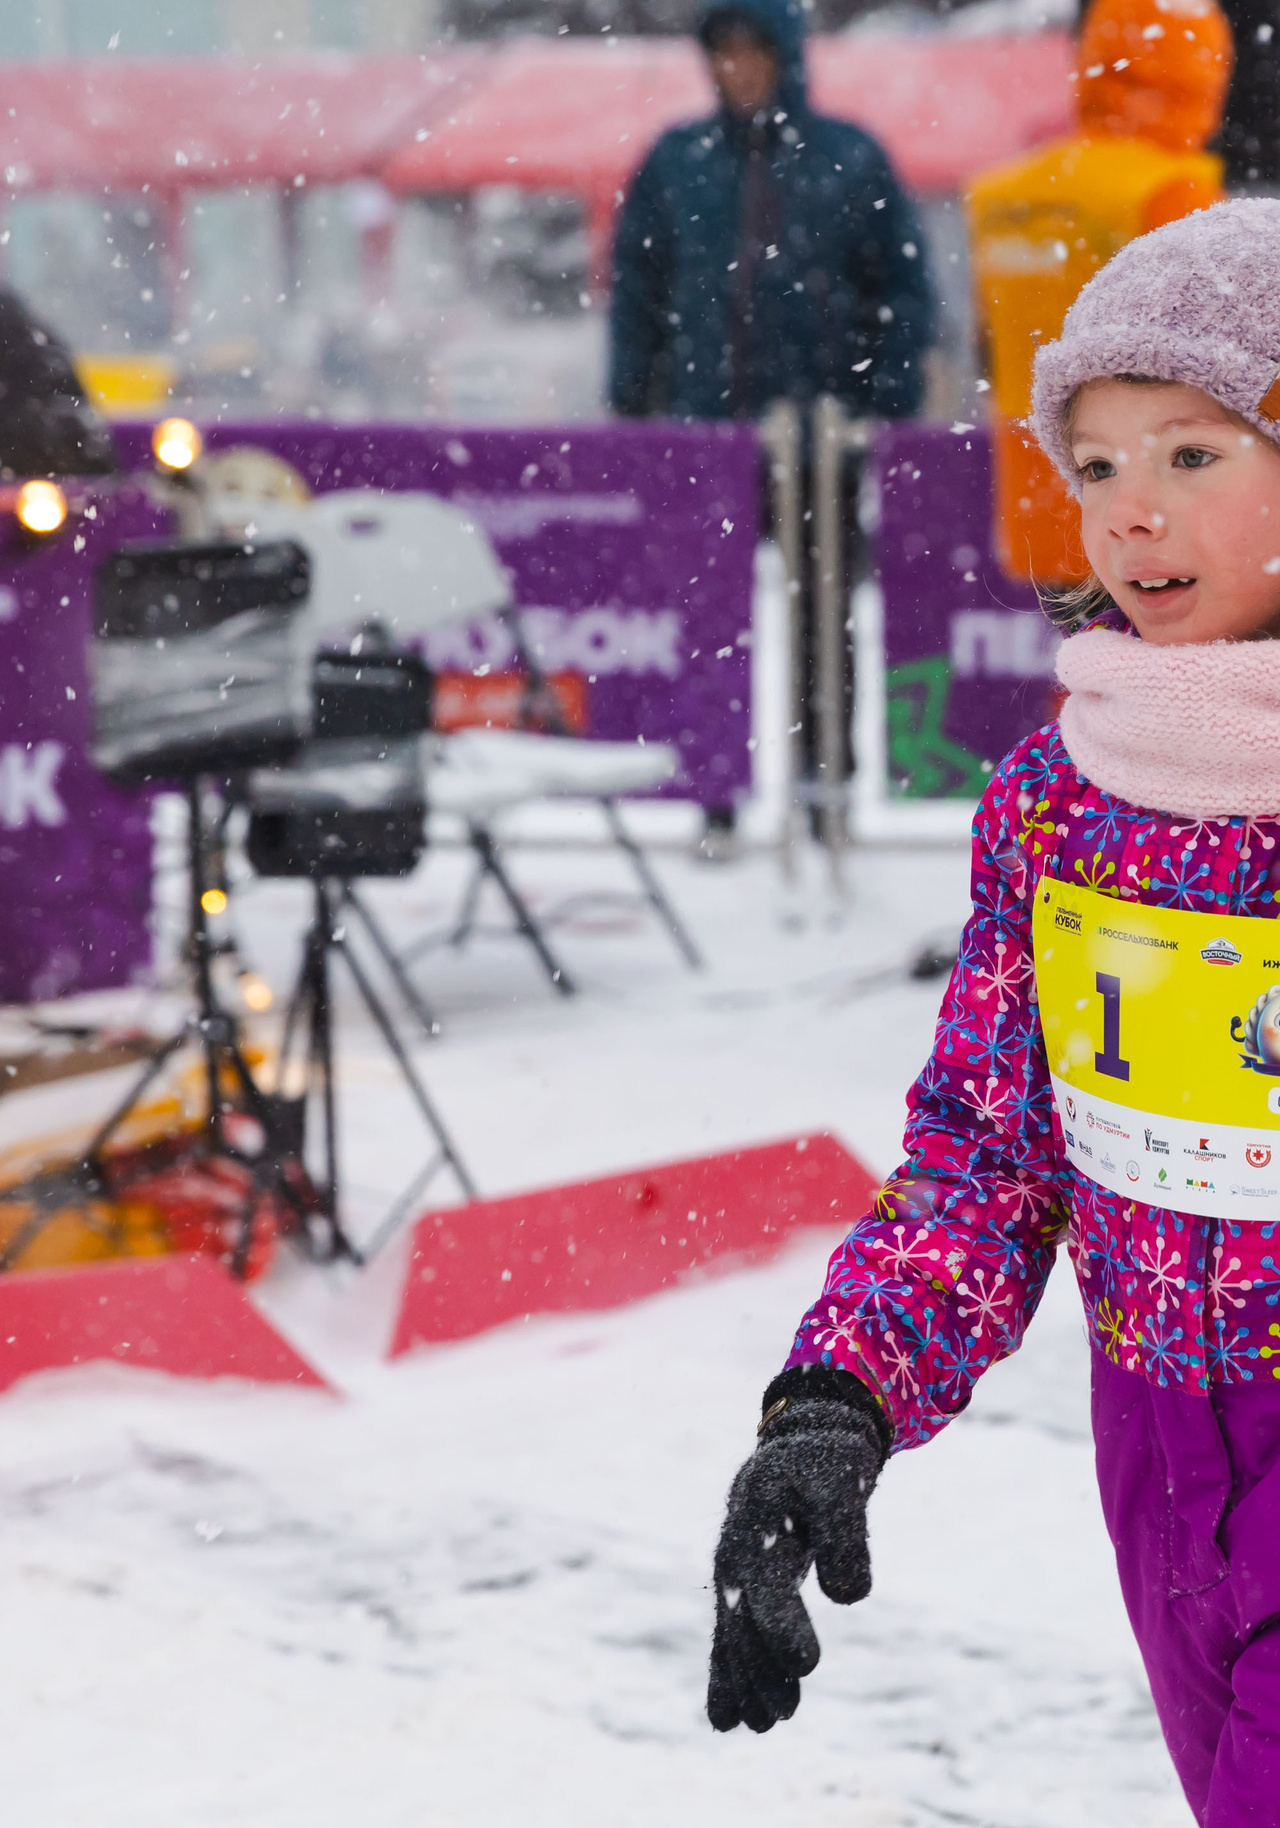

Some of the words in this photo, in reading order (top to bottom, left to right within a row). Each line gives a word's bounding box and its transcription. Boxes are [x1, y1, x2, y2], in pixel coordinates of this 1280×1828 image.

[1055, 913, 1082, 932] КУБОК
[1102, 927, 1179, 951] РОССЕЛЬХОЗБАНК
[1095, 971, 1130, 1082] 1
[1183, 1148, 1227, 1159] КАЛАШНИКОВ
[1194, 1155, 1215, 1163] СПОРТ
